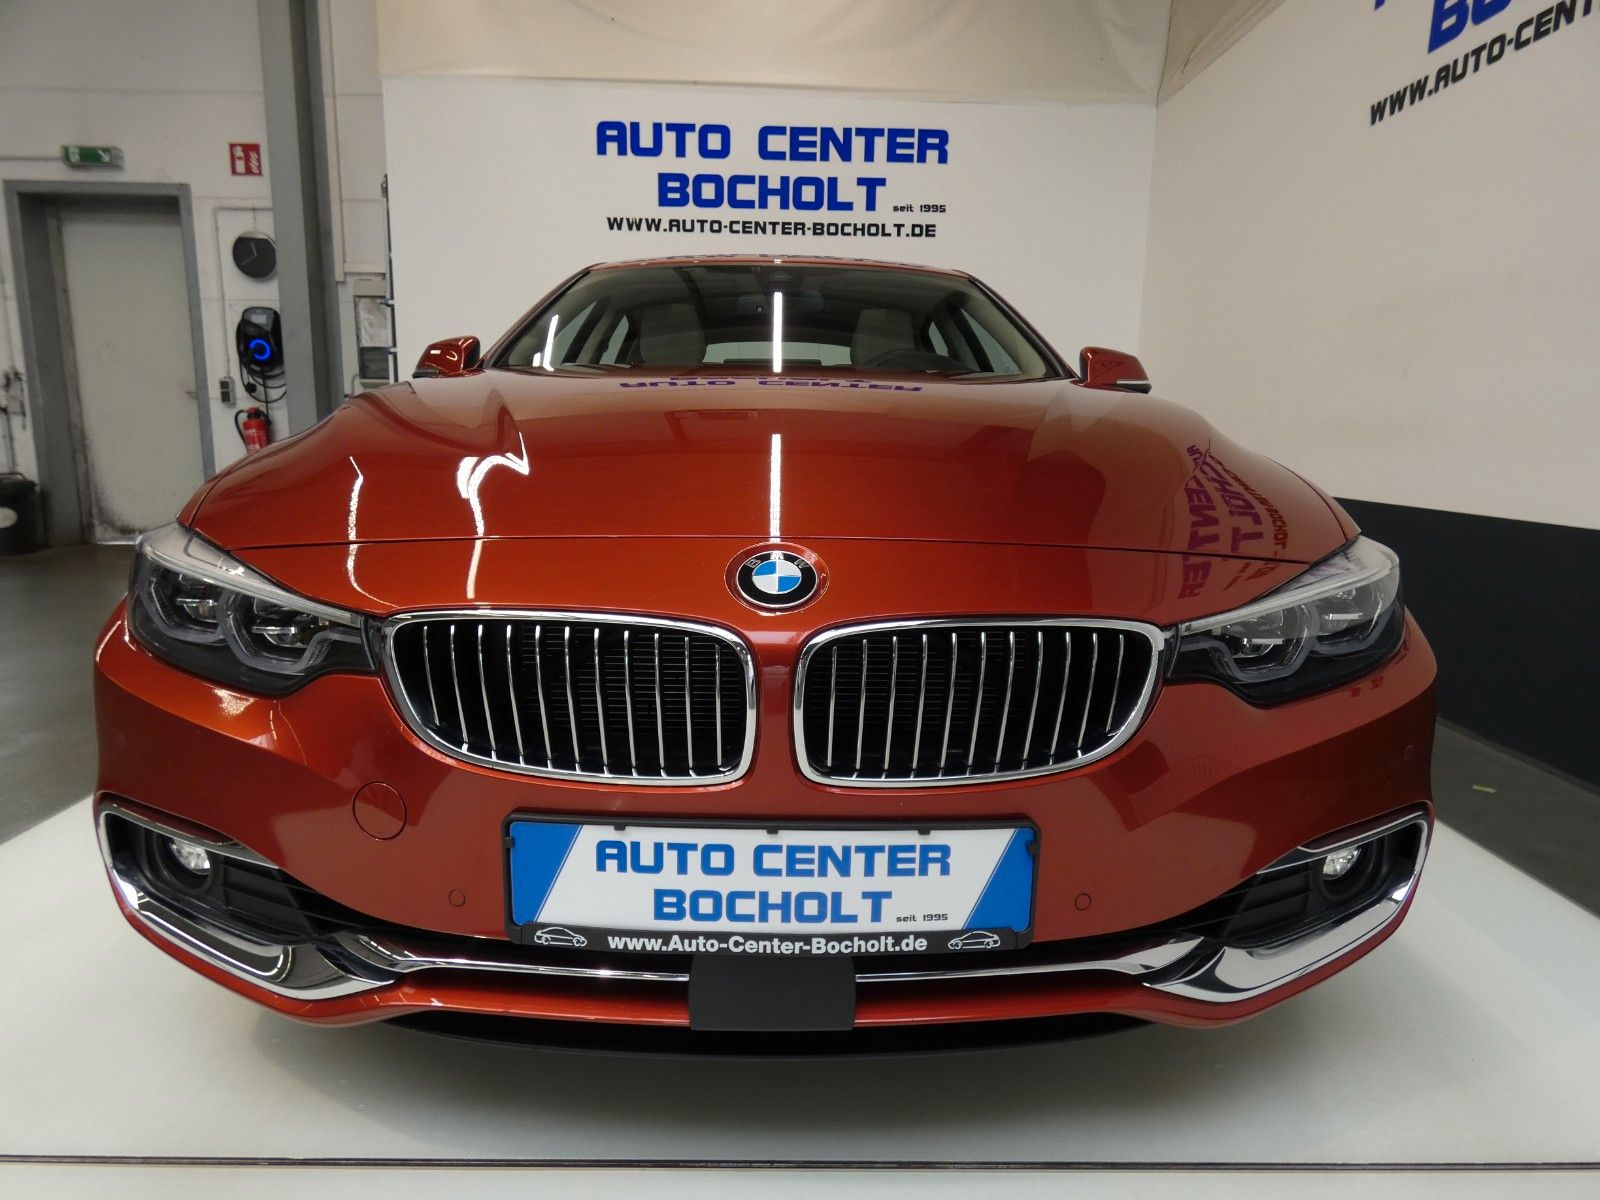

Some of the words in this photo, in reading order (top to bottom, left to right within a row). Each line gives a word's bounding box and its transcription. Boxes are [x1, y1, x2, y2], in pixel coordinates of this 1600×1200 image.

[596, 121, 731, 159] AUTO
[758, 125, 950, 165] CENTER
[657, 172, 887, 212] BOCHOLT
[893, 203, 914, 213] seit
[919, 204, 947, 213] 1995
[607, 216, 937, 238] WWW.AUTO-CENTER-BOCHOLT.DE
[595, 840, 735, 876] AUTO
[752, 844, 951, 878] CENTER
[653, 889, 892, 924] BOCHOLT
[896, 913, 917, 923] seit
[921, 913, 949, 922] 1995
[607, 935, 928, 955] www.Auto-Center-Bocholt.de
